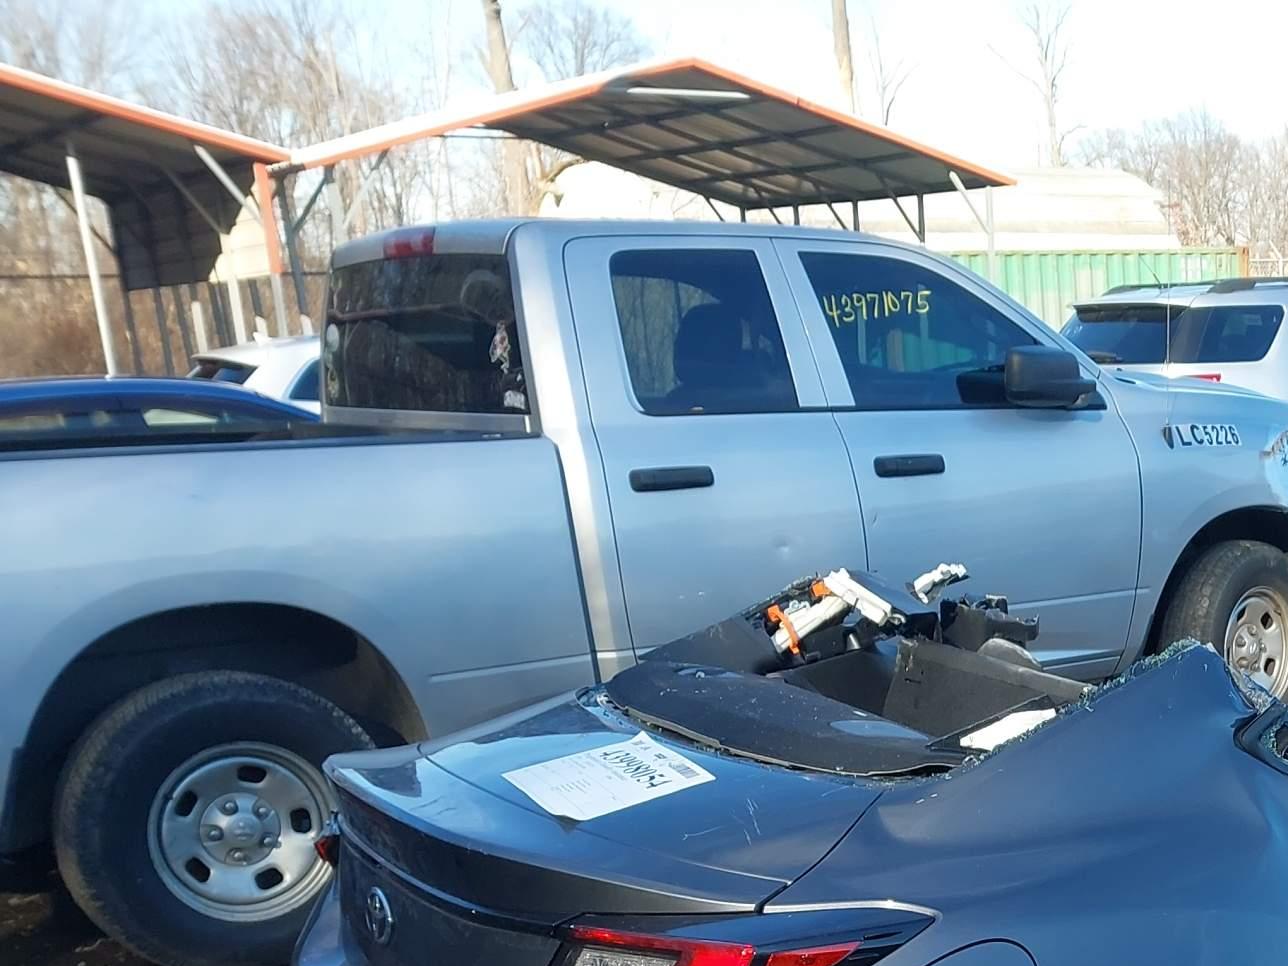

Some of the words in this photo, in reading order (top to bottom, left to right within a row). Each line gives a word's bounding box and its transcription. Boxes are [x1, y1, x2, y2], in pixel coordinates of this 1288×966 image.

[823, 291, 931, 328] 43971075
[1175, 424, 1240, 447] LC5226
[599, 750, 673, 789] 43998054
